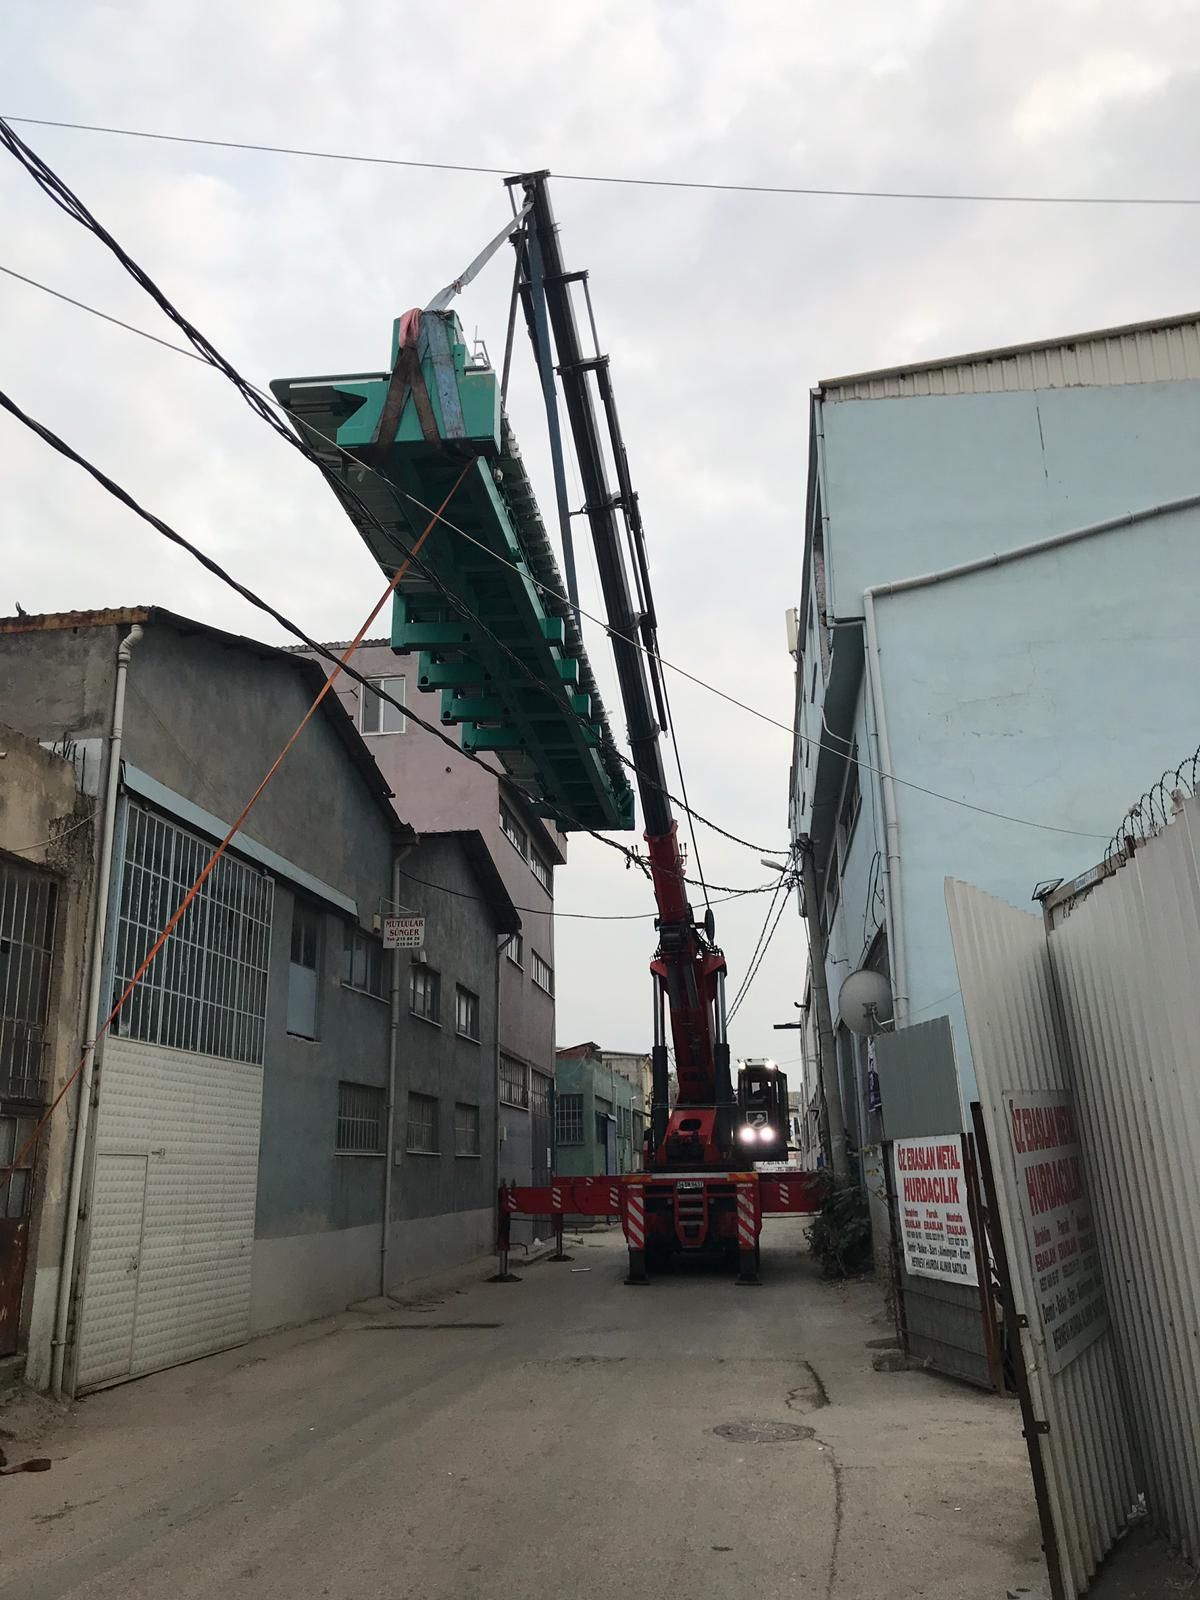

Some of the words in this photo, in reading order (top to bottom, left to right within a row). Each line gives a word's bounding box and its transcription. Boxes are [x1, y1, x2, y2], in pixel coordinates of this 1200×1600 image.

[386, 920, 423, 928] MUTLULAR
[898, 1143, 907, 1171] ÖZ
[906, 1147, 936, 1171] ERASLAN
[935, 1144, 961, 1170] METAL
[904, 1177, 960, 1203] HURDACILIK
[924, 1221, 944, 1231] ERASLAN
